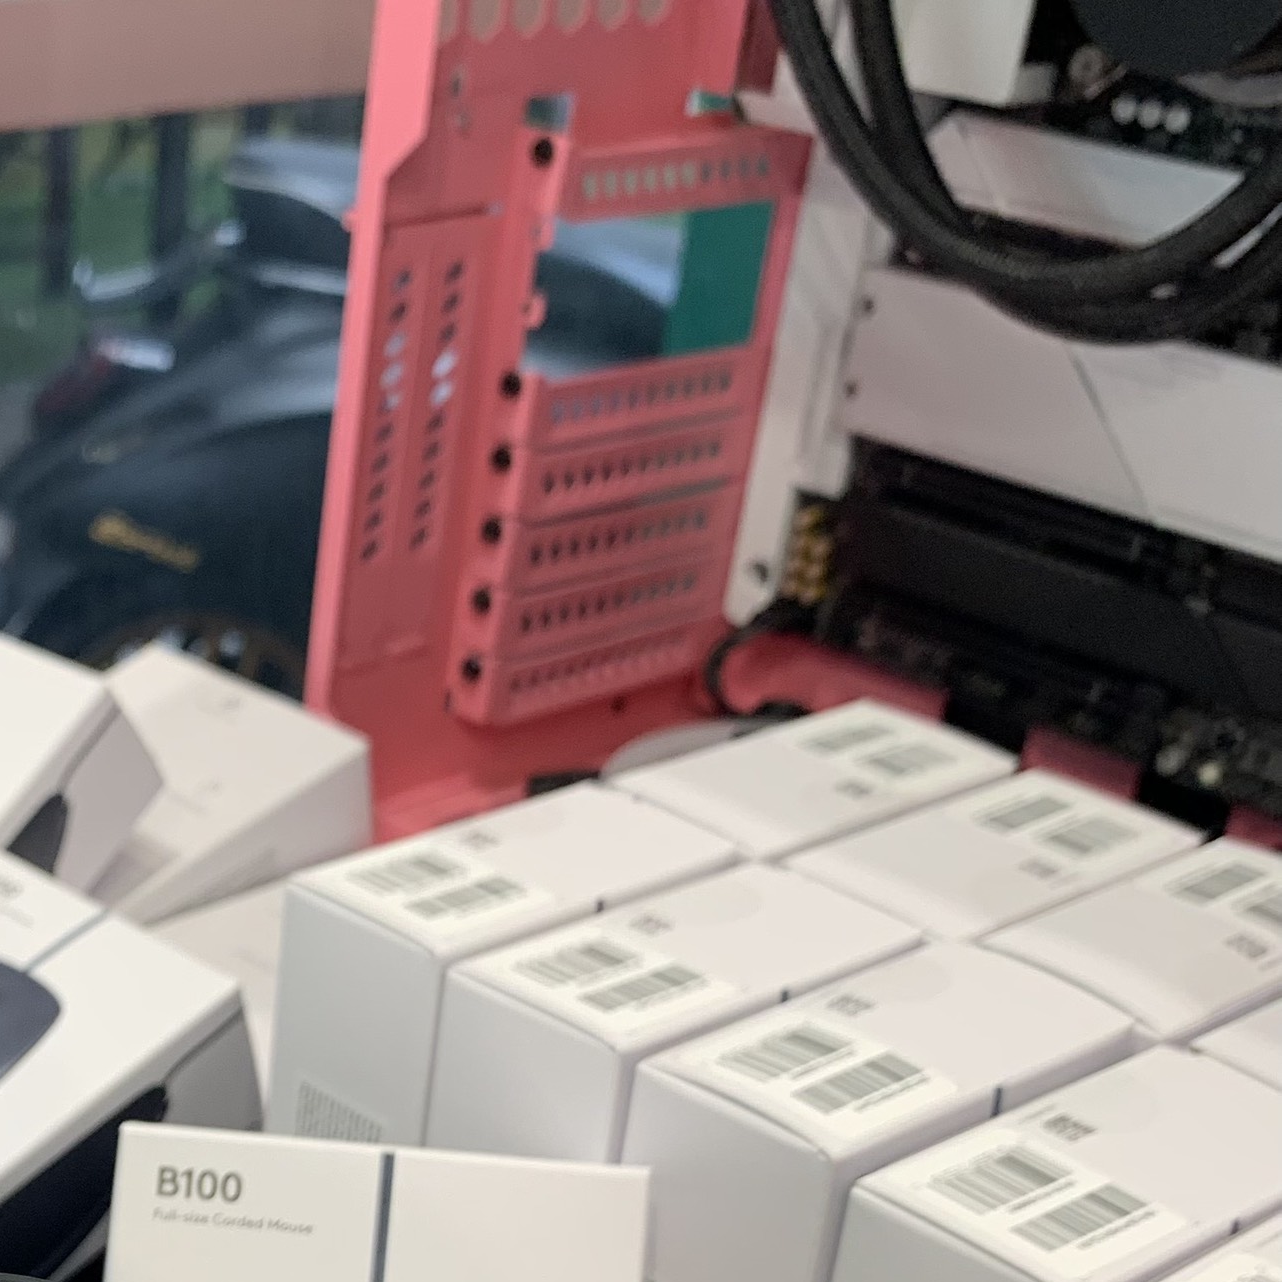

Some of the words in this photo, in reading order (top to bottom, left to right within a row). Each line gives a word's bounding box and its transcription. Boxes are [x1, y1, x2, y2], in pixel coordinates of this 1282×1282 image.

[155, 1165, 243, 1204] B100
[152, 1206, 209, 1224] Full-size
[212, 1211, 264, 1230] Corded
[267, 1217, 314, 1235] Mouse
